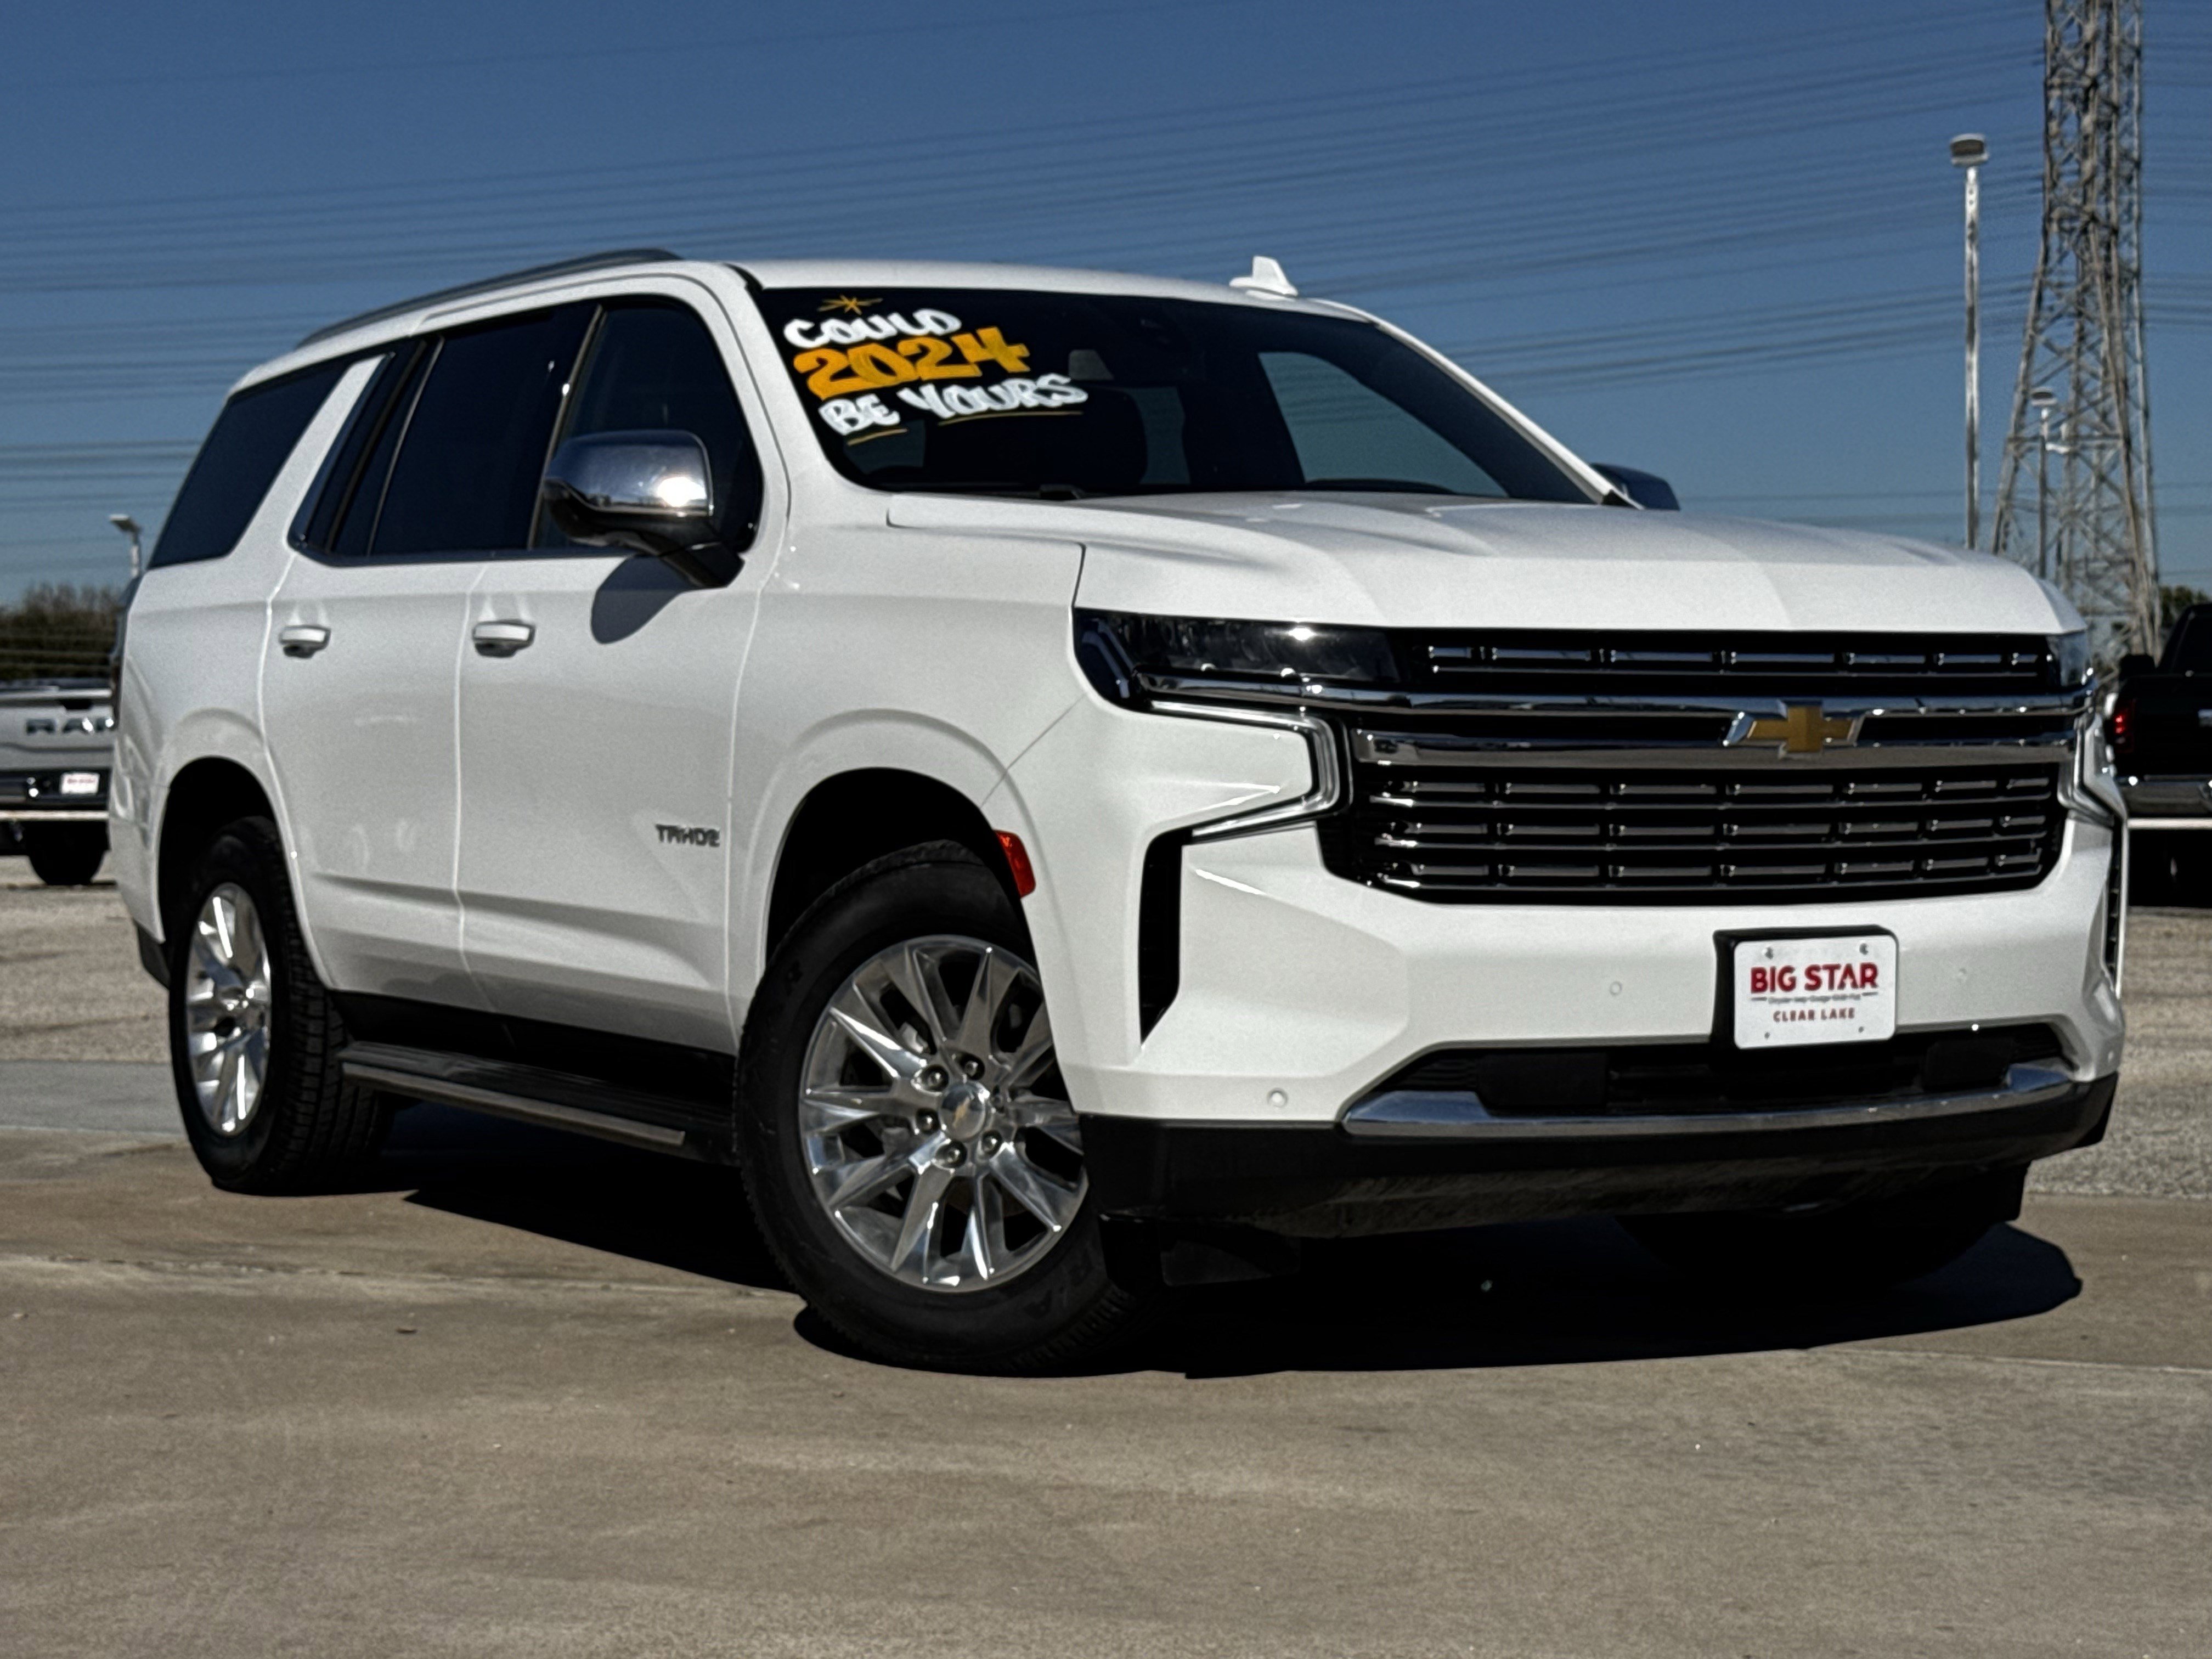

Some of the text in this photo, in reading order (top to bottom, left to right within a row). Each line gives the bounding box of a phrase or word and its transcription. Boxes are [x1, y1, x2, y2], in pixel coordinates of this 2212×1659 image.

[784, 309, 961, 348] COULD
[793, 327, 1030, 400] 2024
[819, 373, 1088, 435] BE YOURS
[655, 824, 720, 848] TAHOE
[1750, 962, 1878, 994] BIG STAR
[1773, 1007, 1855, 1022] CLEAR LAKE
